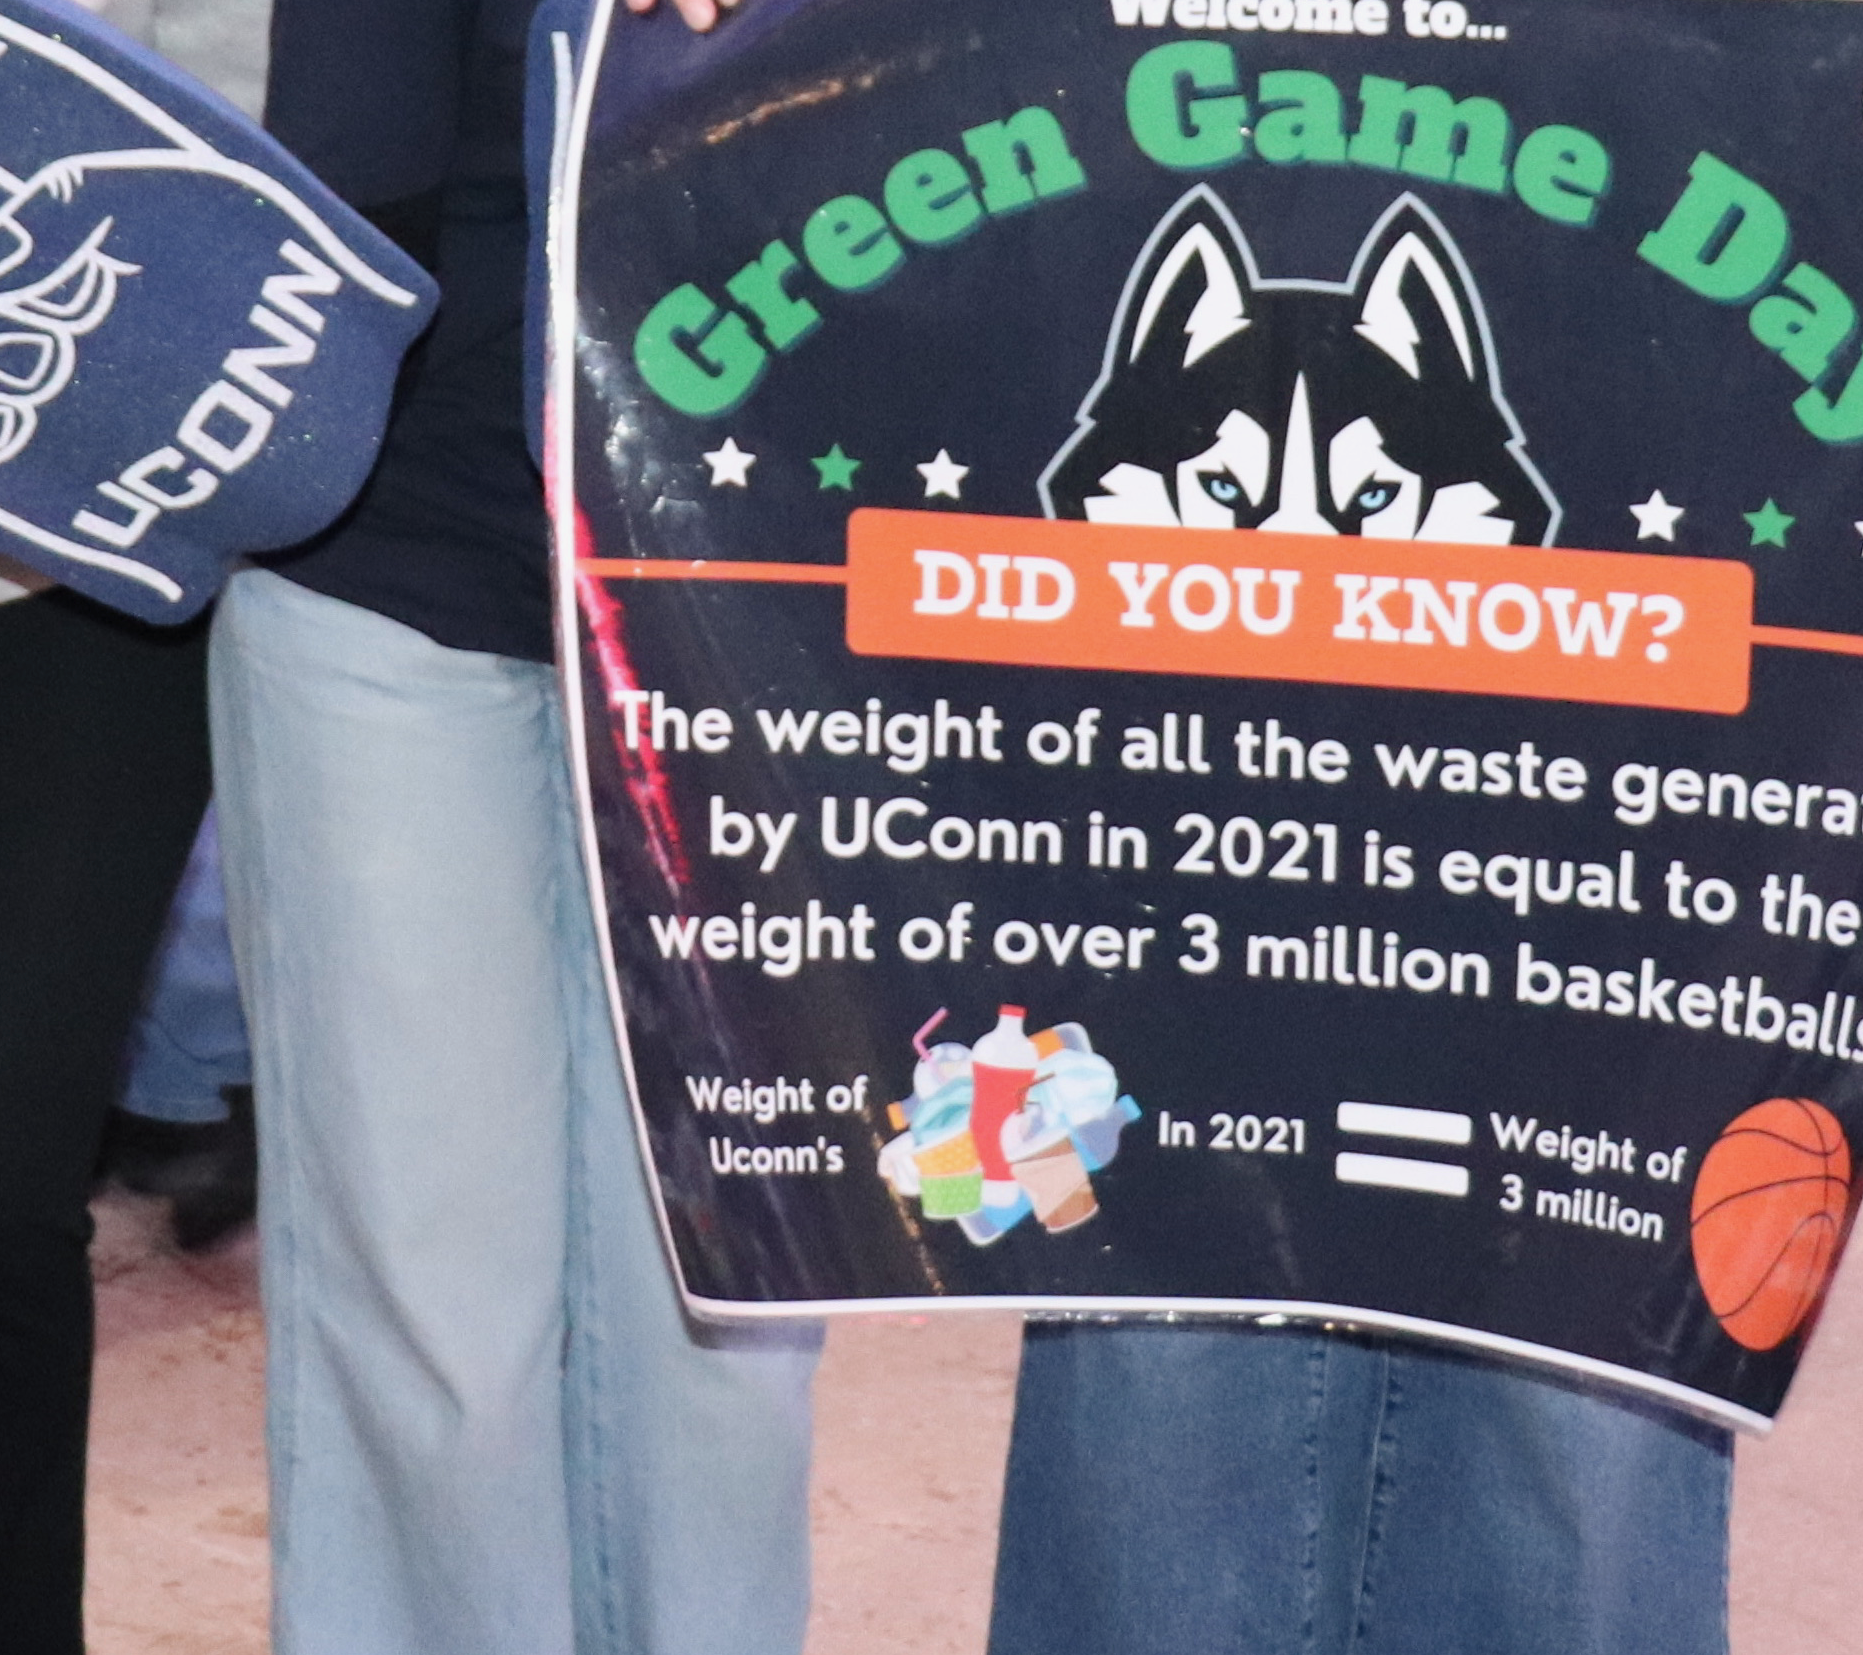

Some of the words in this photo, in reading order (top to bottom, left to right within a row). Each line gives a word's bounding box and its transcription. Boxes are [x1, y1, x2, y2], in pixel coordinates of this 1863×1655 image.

[632, 105, 1088, 418] Green
[1126, 38, 1612, 229] Game
[73, 240, 343, 548] UCONN
[913, 549, 1076, 622] DID
[1108, 563, 1302, 635] YOU
[1333, 572, 1686, 663] KNOW?
[612, 689, 733, 753] The
[755, 697, 1003, 772] weight
[1027, 706, 1101, 766] of
[1120, 713, 1211, 774] all
[1235, 719, 1350, 783] the
[1375, 741, 1587, 802] waste
[708, 795, 796, 872] by
[820, 796, 1062, 864] UConn
[1088, 811, 1147, 869] in
[1172, 813, 1338, 881] 2021
[1363, 830, 1414, 888] is
[1439, 847, 1639, 915] equal
[1665, 861, 1736, 924] to
[1760, 874, 1862, 946] the
[649, 900, 876, 978] weight
[899, 902, 974, 963] of
[993, 920, 1155, 968] over
[1179, 914, 1219, 974] 3
[1246, 925, 1490, 997] million
[685, 1075, 816, 1124] Weight
[826, 1075, 869, 1113] of
[1158, 1110, 1195, 1147] In
[1208, 1113, 1305, 1154] 2021
[1489, 1112, 1634, 1174] Weight
[1646, 1147, 1687, 1183] of
[709, 1136, 844, 1175] Uconn's
[1499, 1174, 1523, 1211] 3
[1536, 1189, 1664, 1241] million
